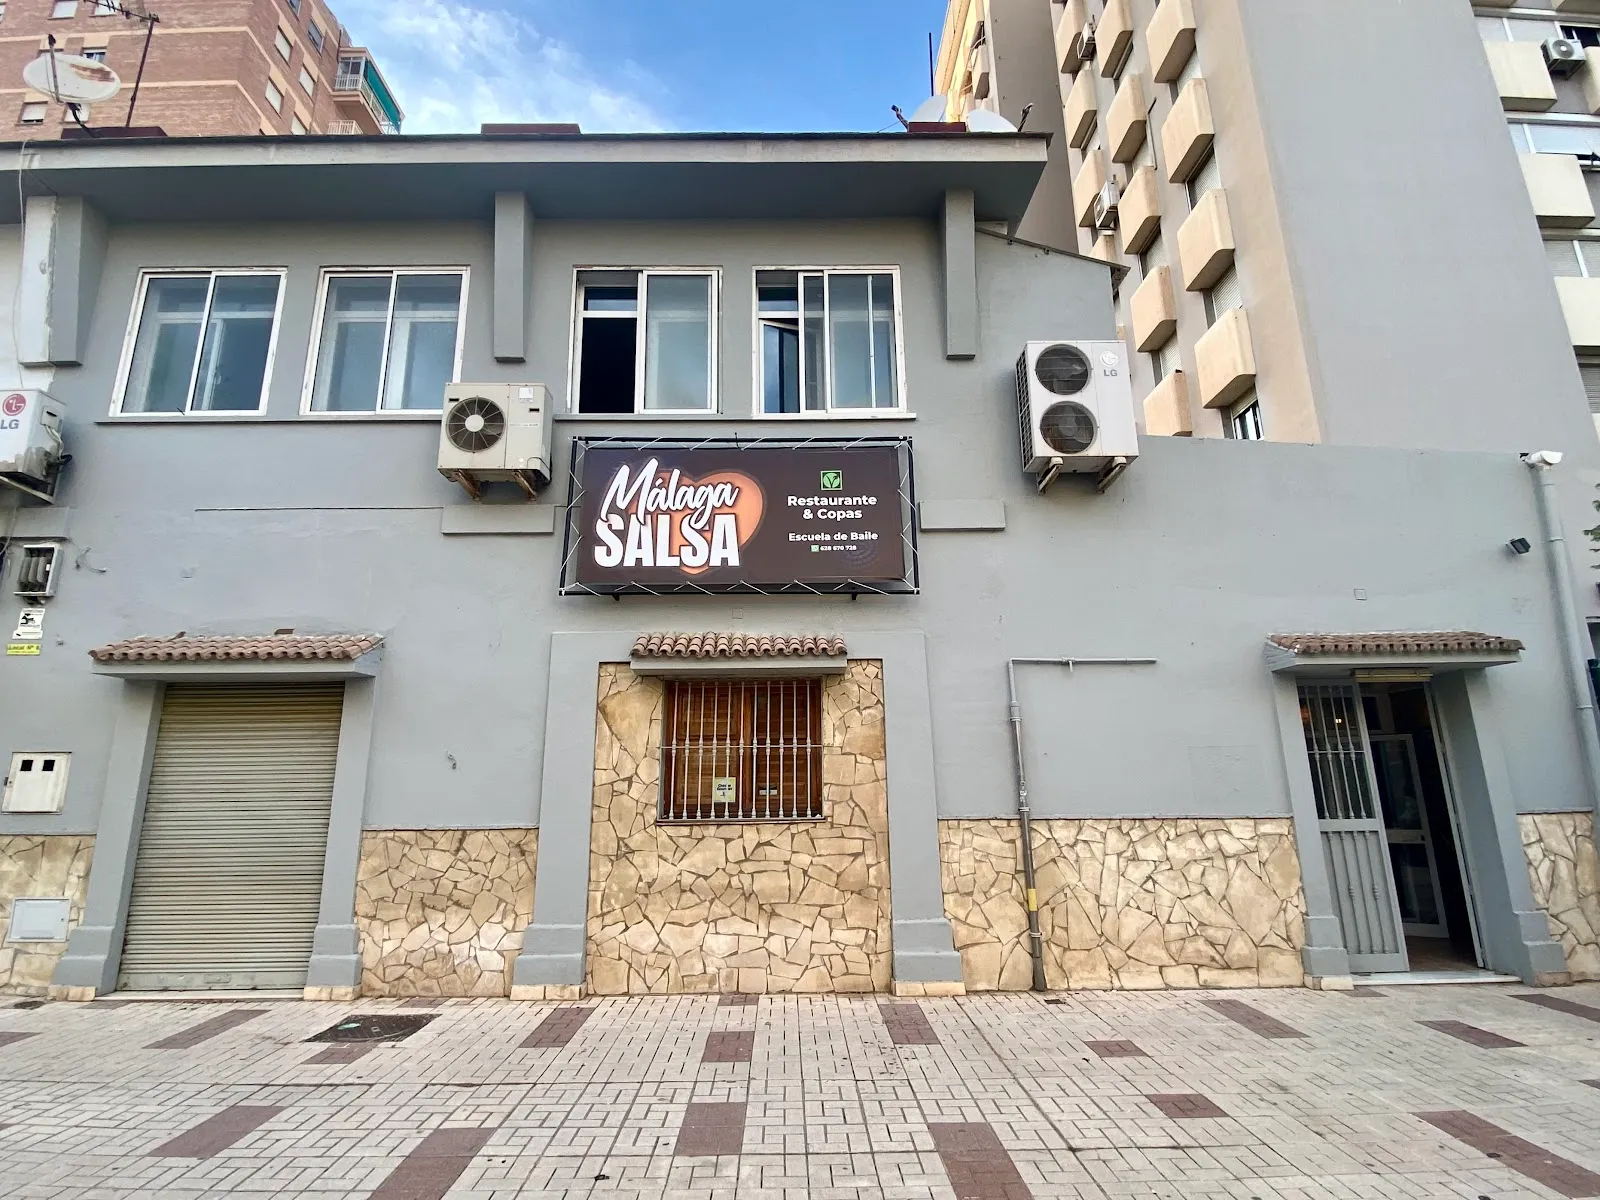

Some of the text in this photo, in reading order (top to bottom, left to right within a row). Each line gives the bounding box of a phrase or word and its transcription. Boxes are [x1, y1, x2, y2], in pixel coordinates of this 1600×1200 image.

[1103, 369, 1118, 377] LG
[0, 419, 20, 430] LG
[600, 457, 740, 530] Málaga
[787, 495, 878, 507] Restaurante
[802, 508, 863, 522] & Copas
[594, 513, 740, 568] SALSA
[788, 531, 879, 542] Escuela de Baile
